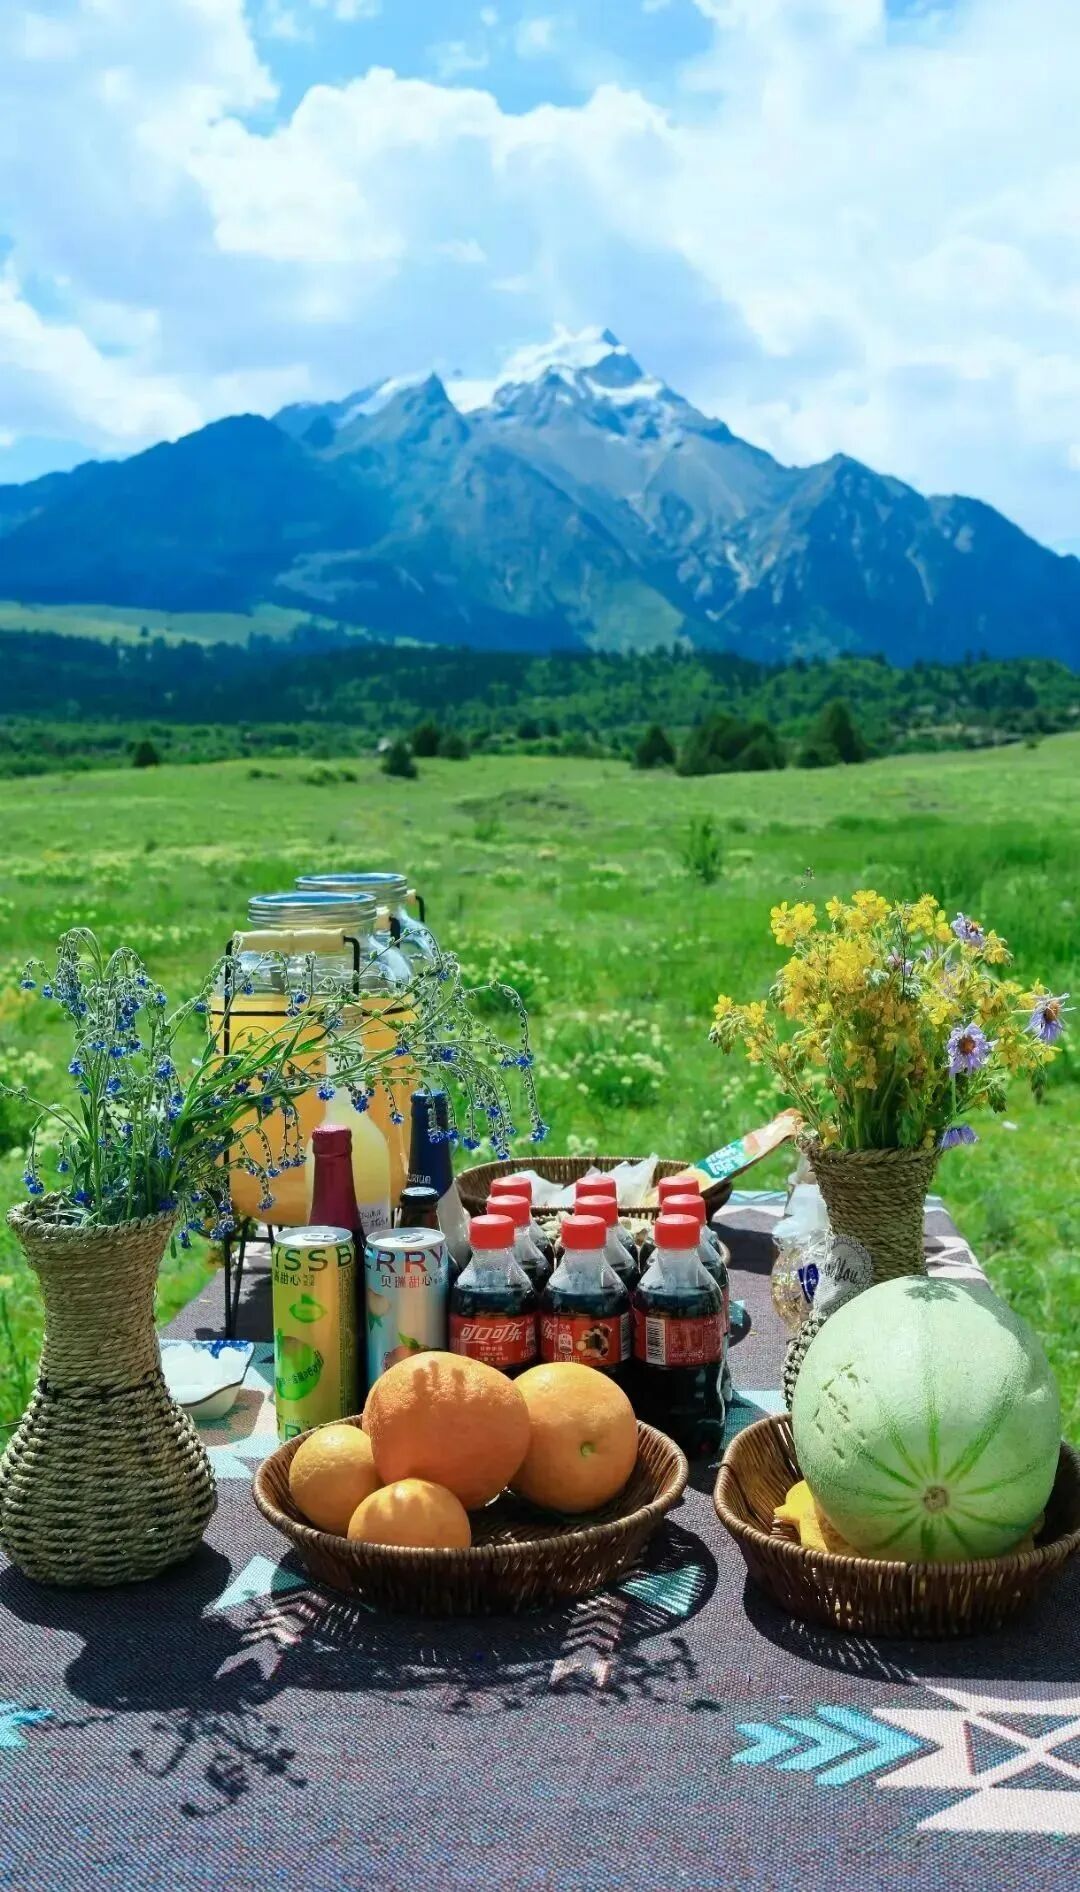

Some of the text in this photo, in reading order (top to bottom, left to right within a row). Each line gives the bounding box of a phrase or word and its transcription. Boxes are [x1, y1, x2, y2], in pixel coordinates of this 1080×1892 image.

[381, 1274, 433, 1289] 贝瑞甜心
[460, 1321, 525, 1344] 可口可乐
